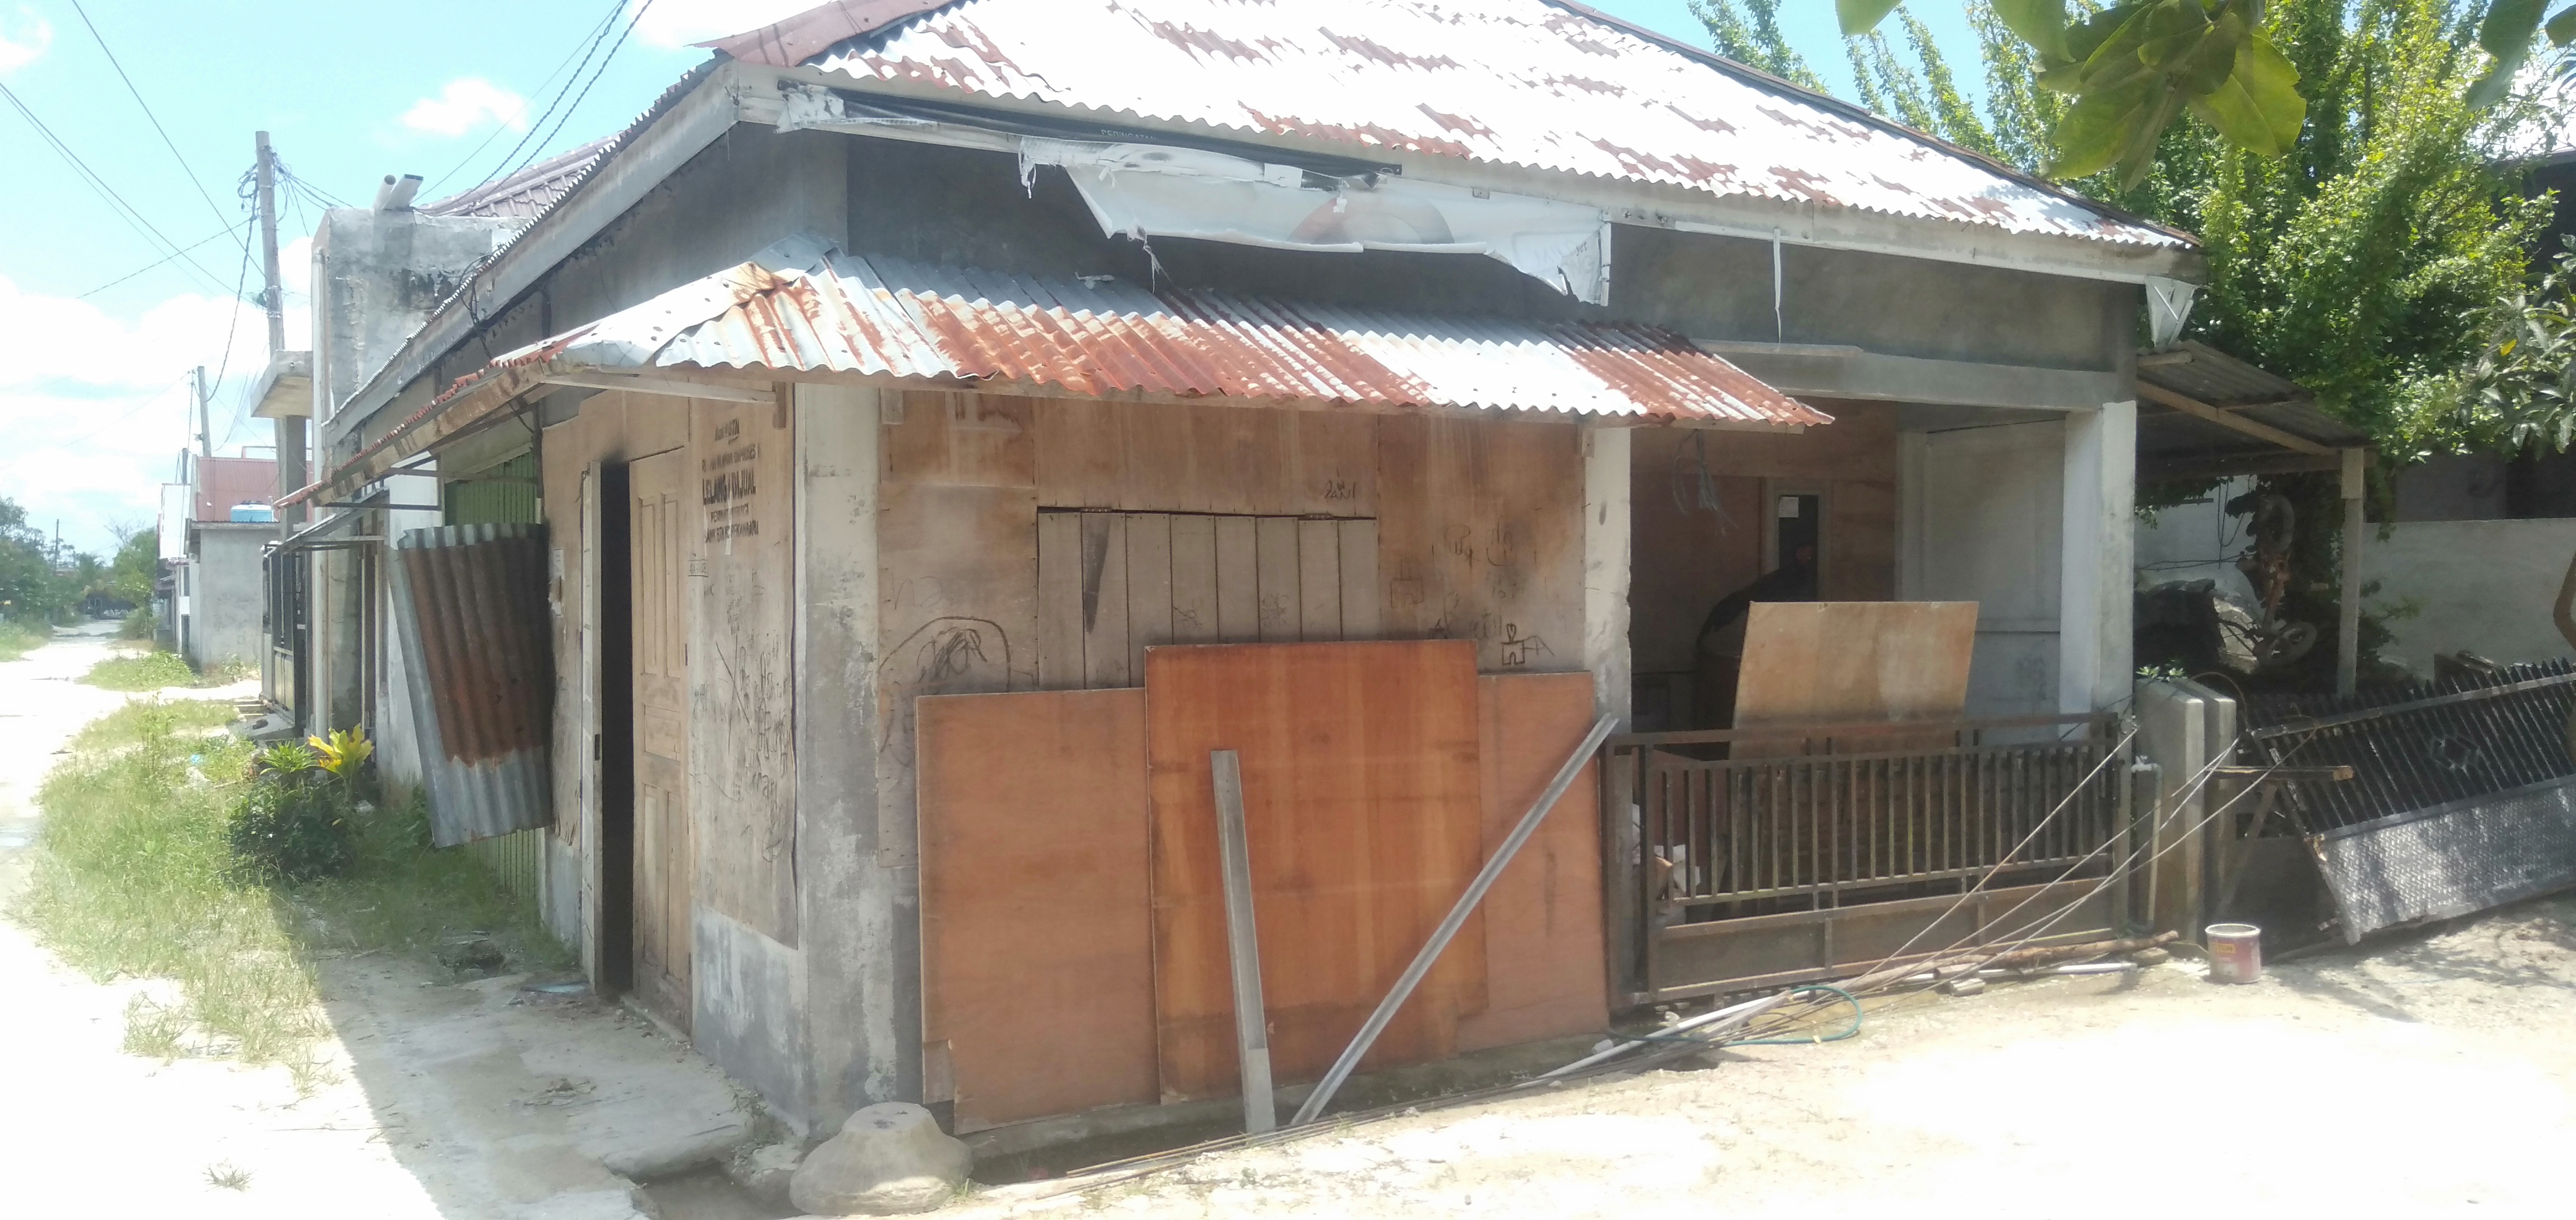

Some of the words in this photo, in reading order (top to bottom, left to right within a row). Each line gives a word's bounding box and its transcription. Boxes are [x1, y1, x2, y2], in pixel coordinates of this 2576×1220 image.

[1575, 241, 1588, 257] yet
[702, 473, 728, 506] LELANG
[731, 467, 757, 500] DIJUAL
